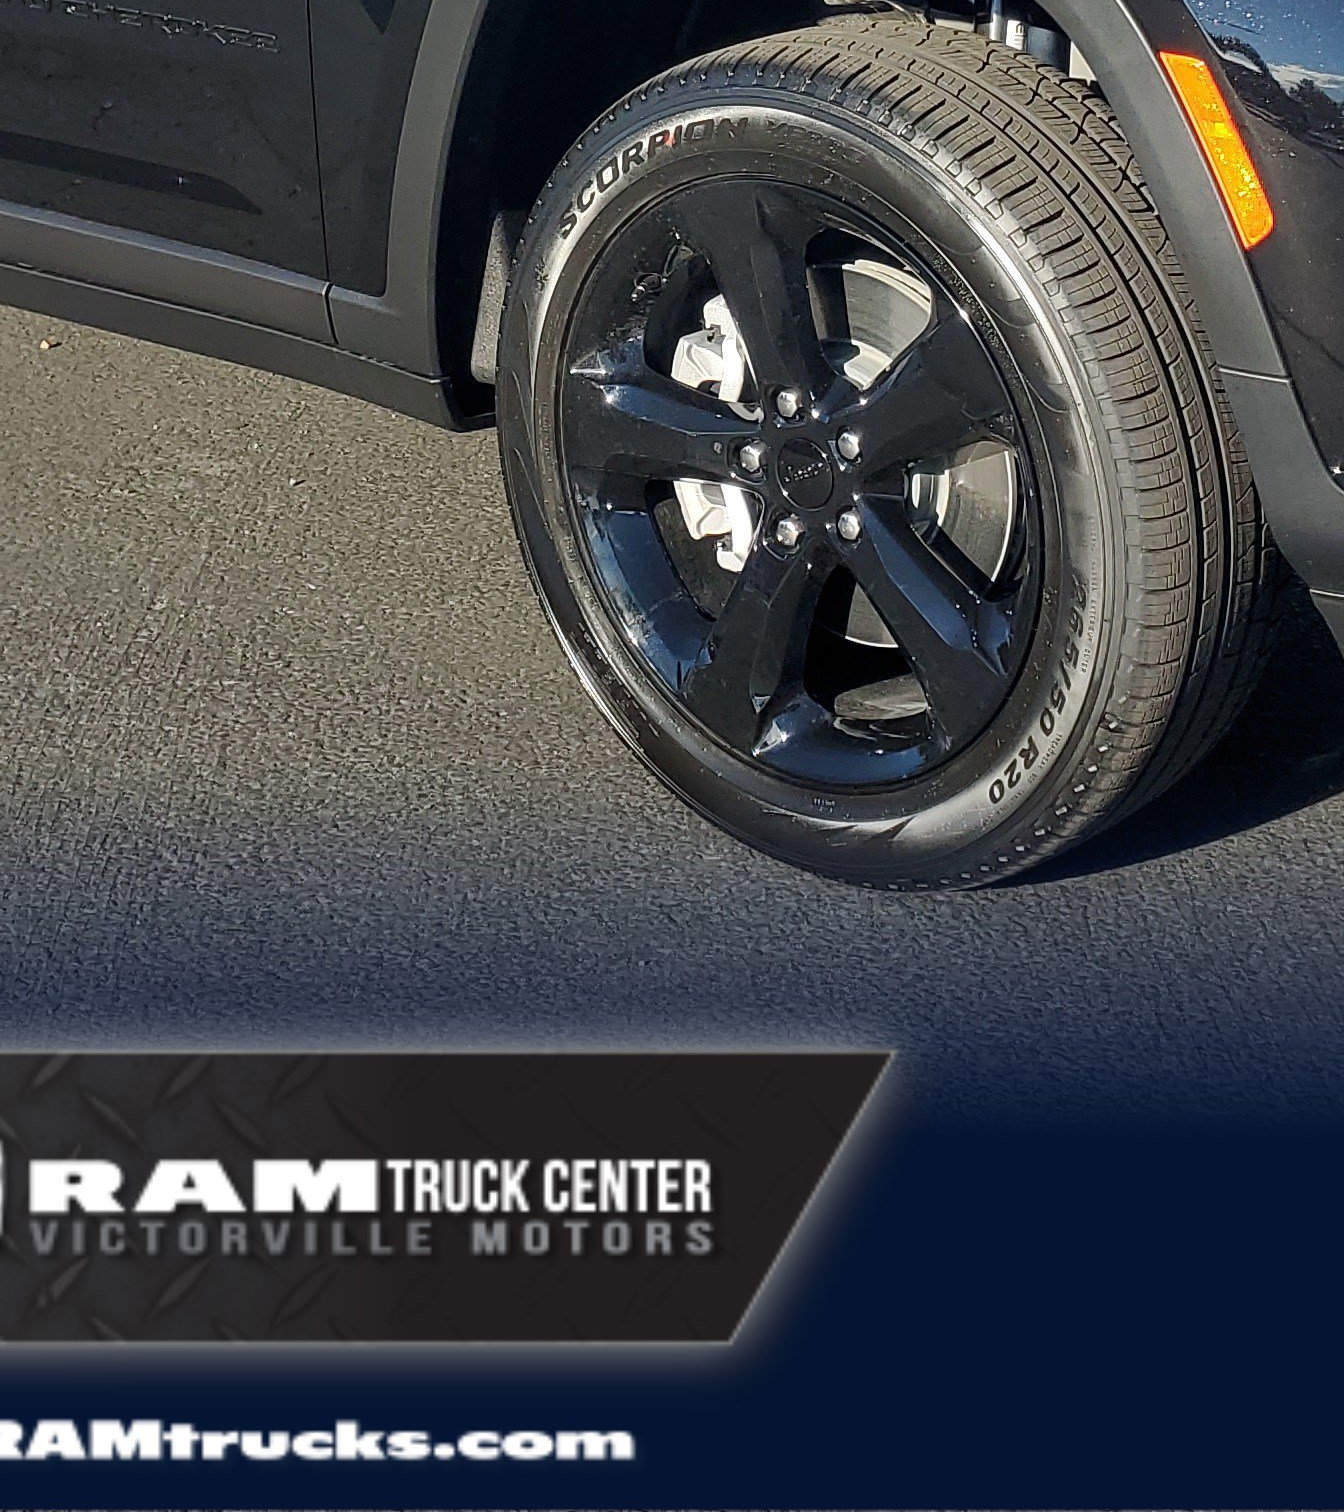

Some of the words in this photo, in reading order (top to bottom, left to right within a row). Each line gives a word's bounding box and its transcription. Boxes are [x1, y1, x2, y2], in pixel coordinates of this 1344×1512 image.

[556, 117, 749, 240] SCORPION
[1039, 573, 1088, 738] 265/50
[988, 735, 1040, 805] R20
